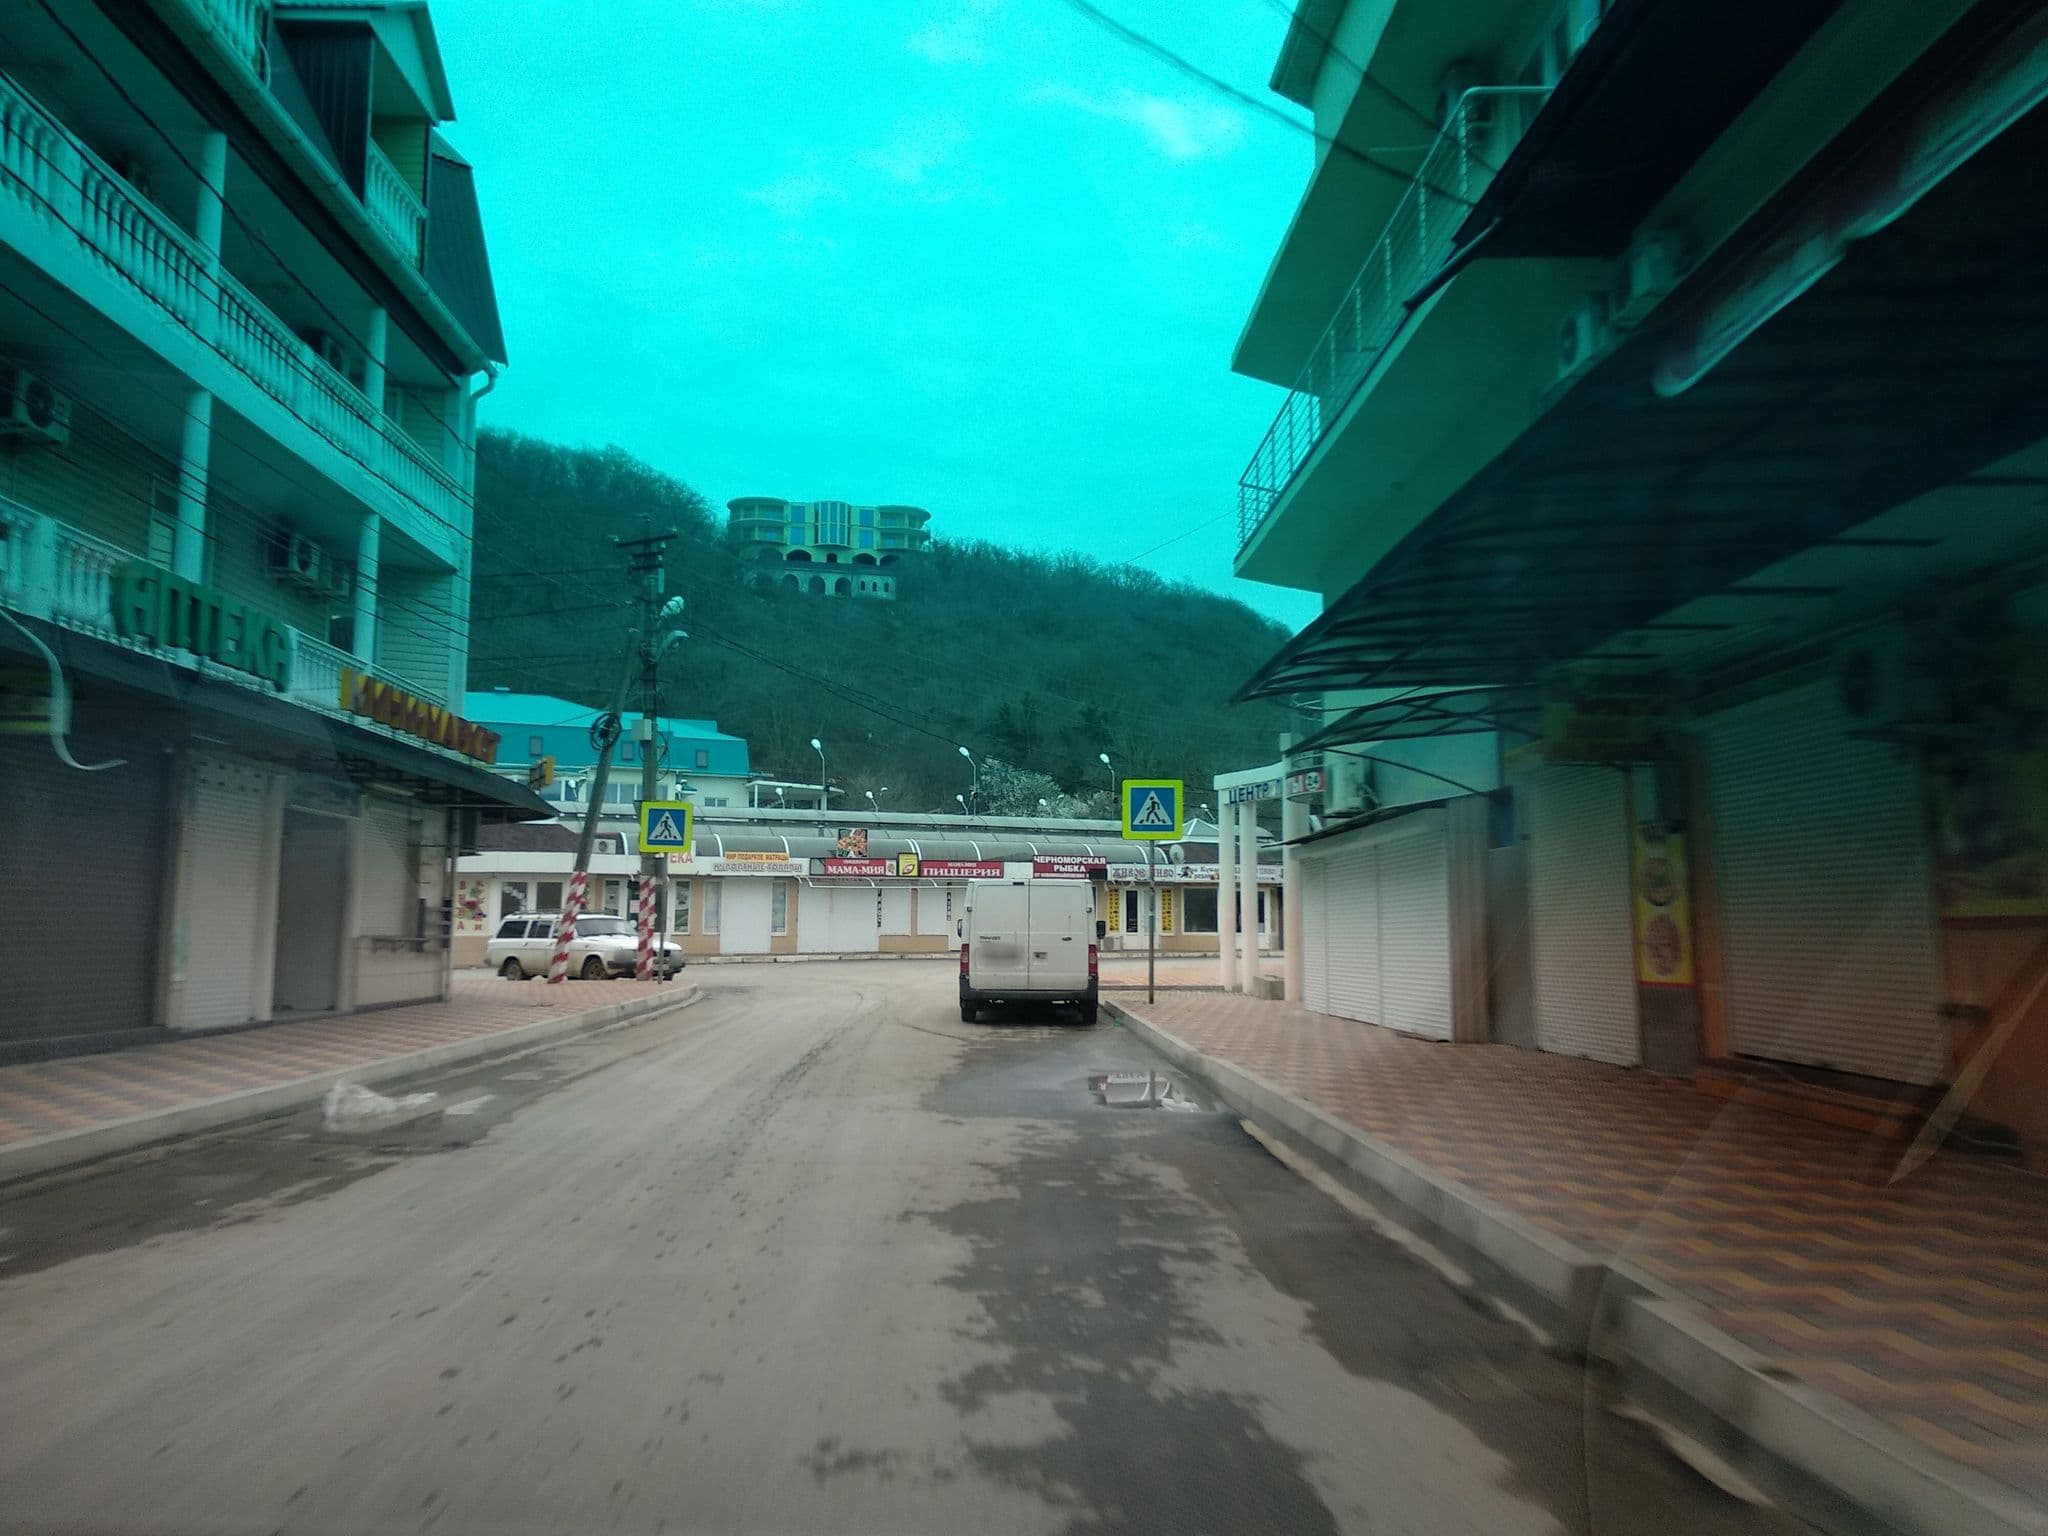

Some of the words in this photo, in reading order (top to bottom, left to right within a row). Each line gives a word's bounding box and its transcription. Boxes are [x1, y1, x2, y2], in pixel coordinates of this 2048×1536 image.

[112, 560, 290, 693] АПТЕКА
[1229, 782, 1269, 805] ЦЕНТР
[670, 854, 693, 864] ЕКА
[1033, 856, 1106, 865] ЧЕРНОМОРСКАЯ
[827, 865, 885, 875] МАМА-МИЯ
[923, 867, 1001, 877] ПИЦЦЕРИЯ
[1053, 864, 1086, 872] РЫБКА
[1112, 867, 1146, 878] ЖИВОЕ
[1152, 868, 1175, 878] ИВО
